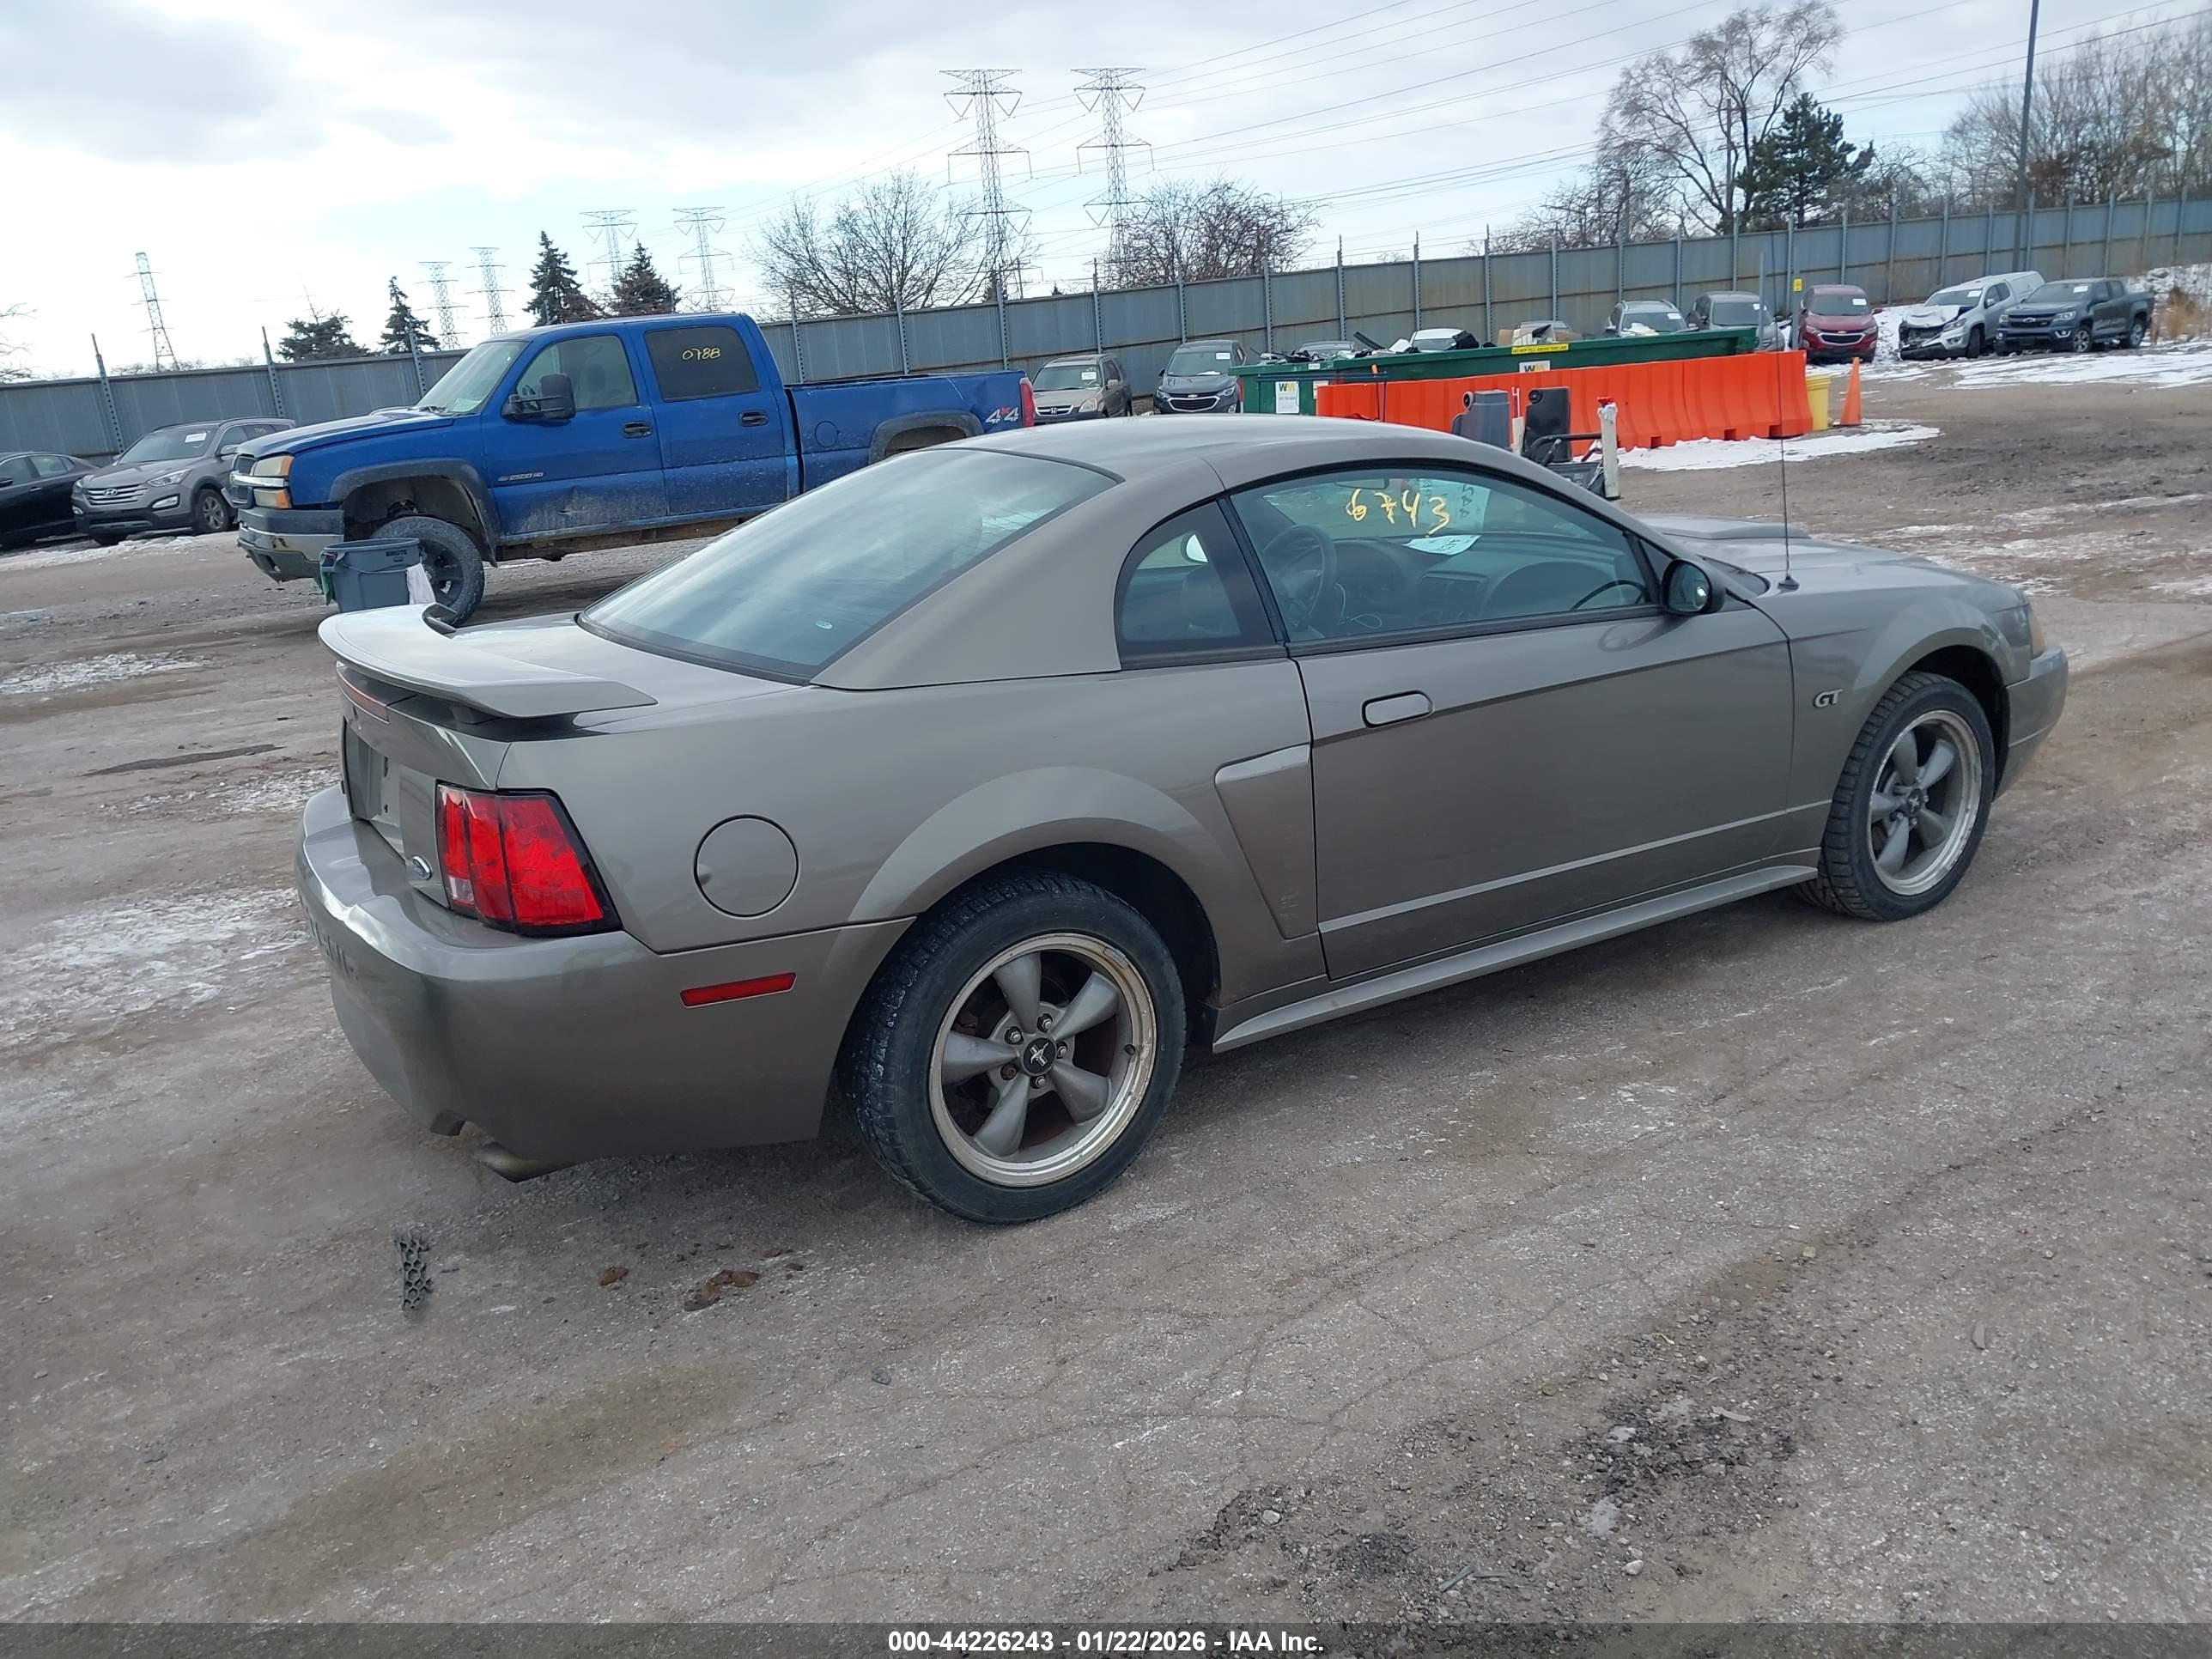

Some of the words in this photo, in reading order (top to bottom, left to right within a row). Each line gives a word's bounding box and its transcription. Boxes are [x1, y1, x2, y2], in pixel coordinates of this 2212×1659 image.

[682, 347, 721, 361] 0788
[1346, 488, 1450, 538] 6743
[1814, 689, 1844, 708] GT
